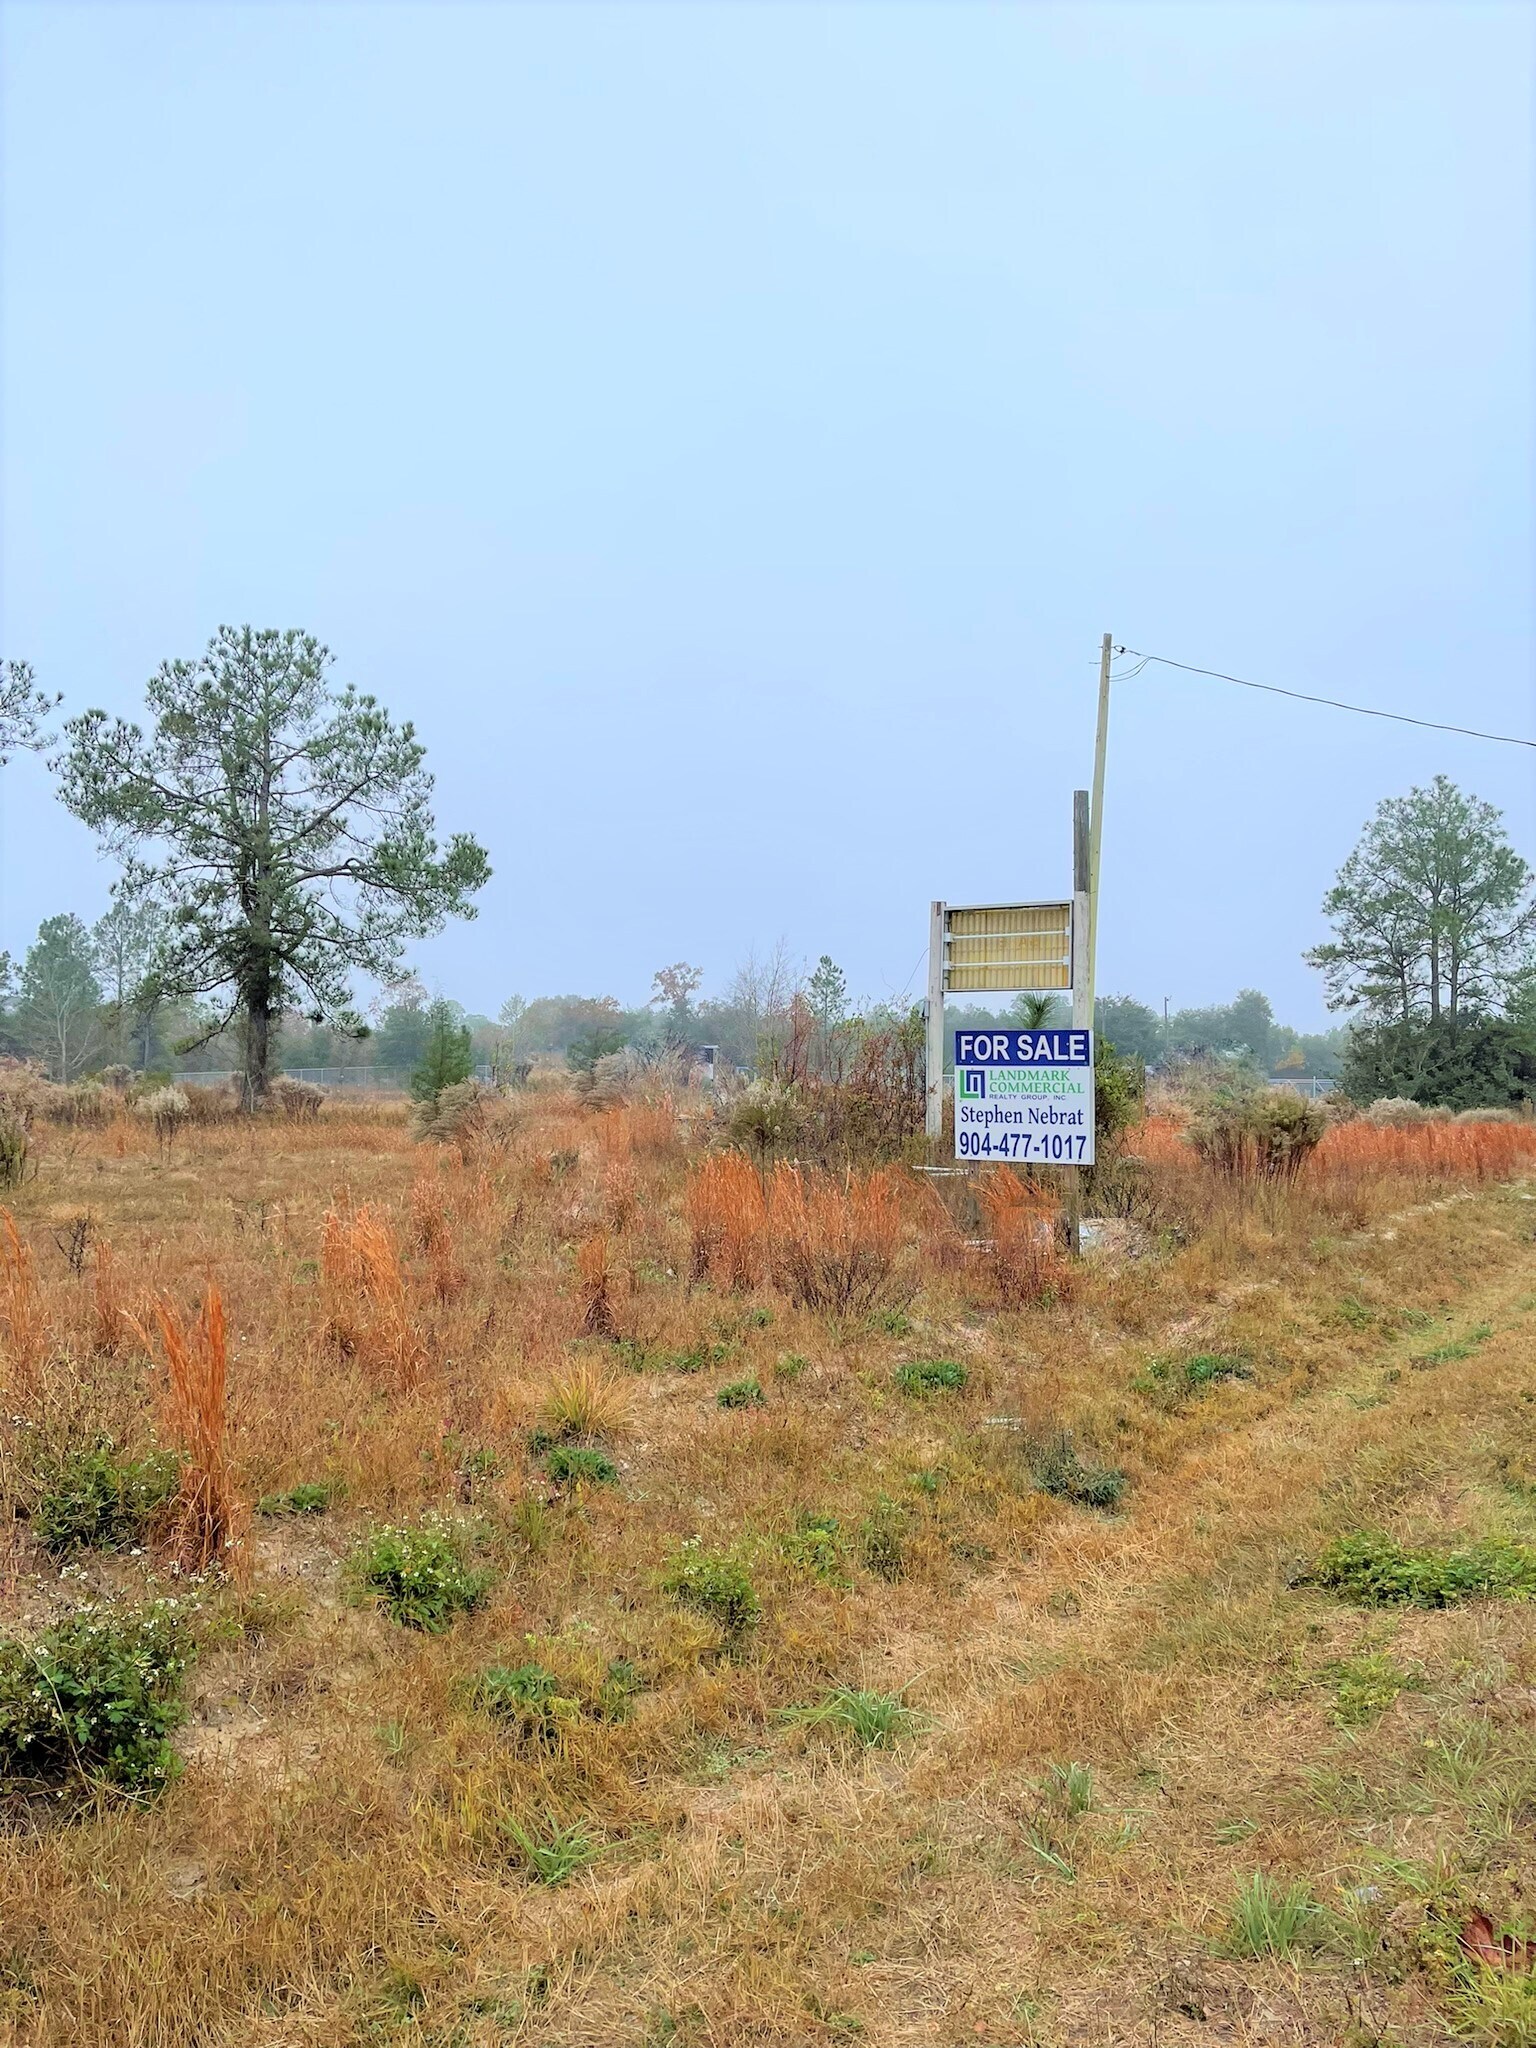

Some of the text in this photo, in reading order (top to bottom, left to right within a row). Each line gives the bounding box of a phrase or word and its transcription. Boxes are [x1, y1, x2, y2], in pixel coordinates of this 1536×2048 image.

[960, 1034, 1085, 1061] FOR SALE
[989, 1070, 1070, 1082] LANDMARK
[989, 1081, 1085, 1094] COMMERCIAL
[961, 1104, 1084, 1128] Stephen Nebrat
[959, 1131, 1087, 1160] 904-477-1017
